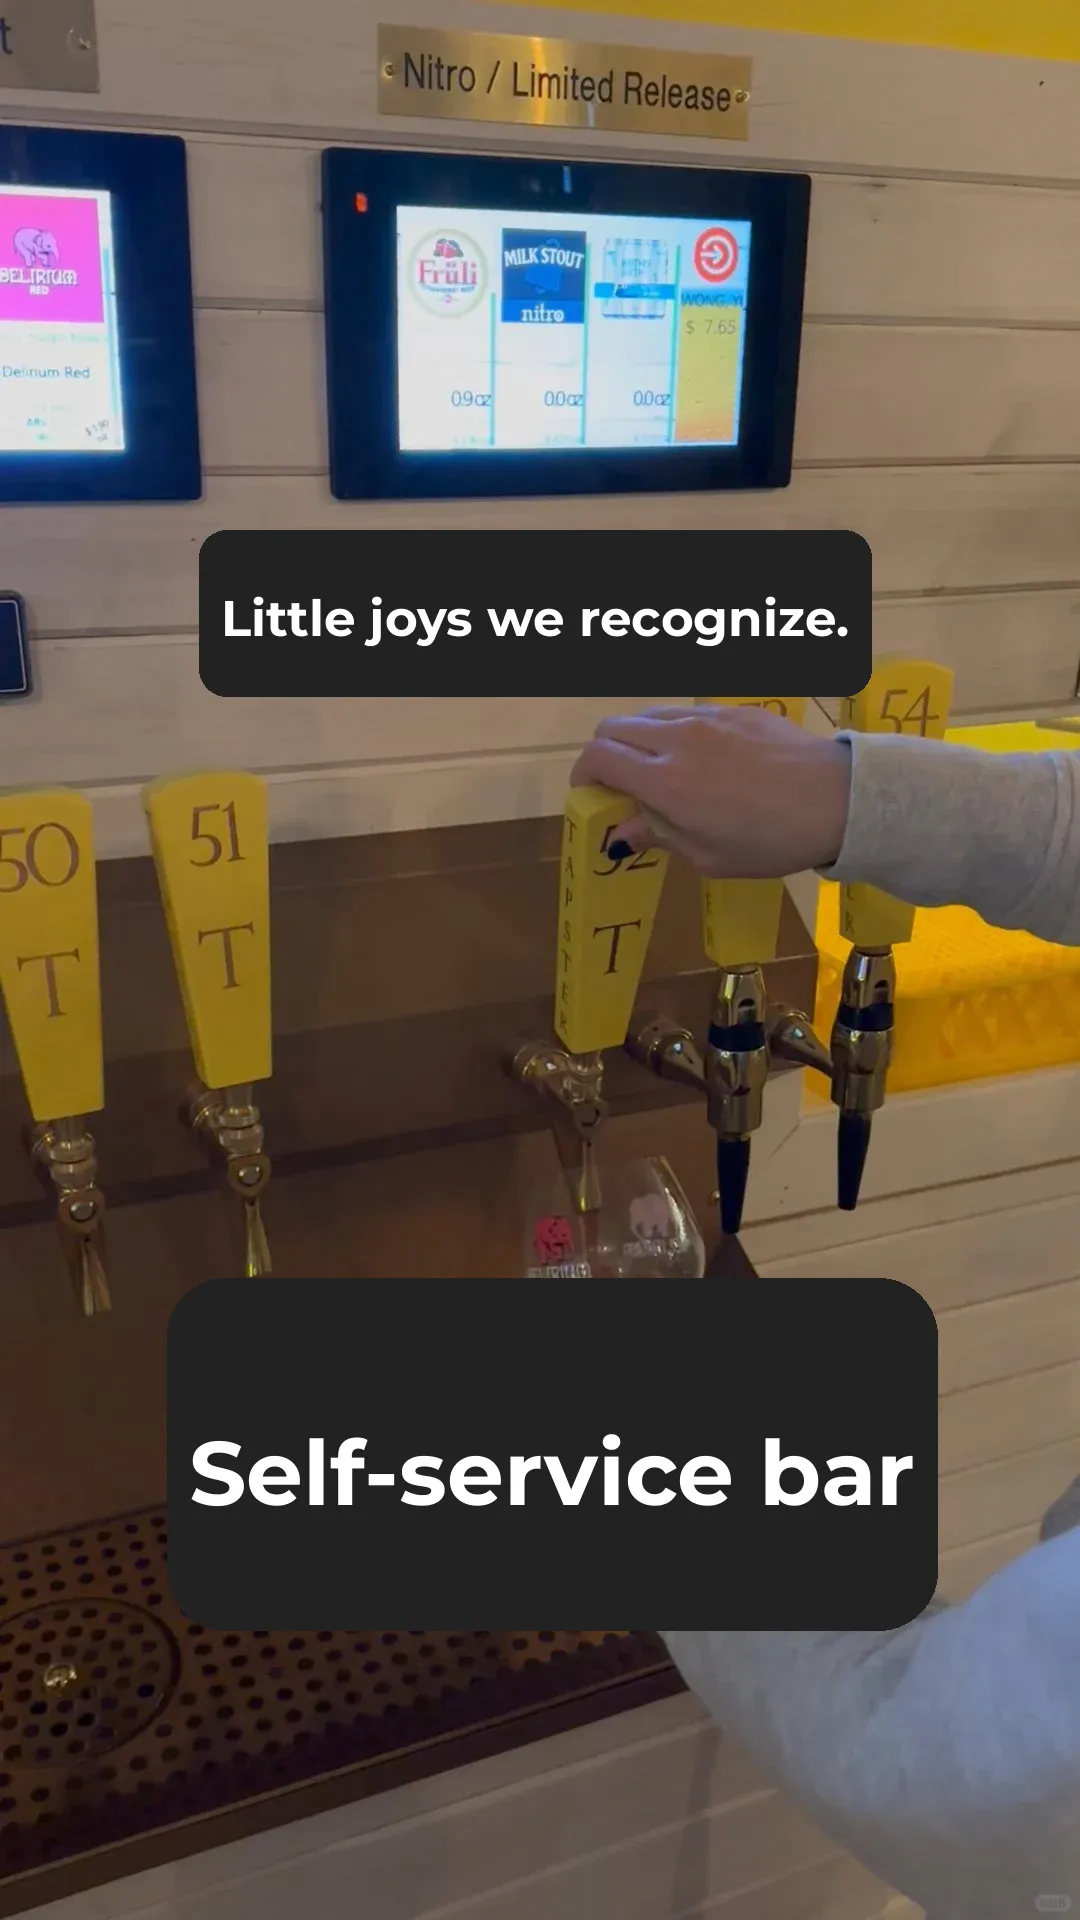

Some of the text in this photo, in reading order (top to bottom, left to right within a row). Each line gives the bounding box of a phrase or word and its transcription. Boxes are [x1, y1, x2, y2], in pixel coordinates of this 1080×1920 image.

[403, 52, 731, 112] Nitro / Limited Release
[418, 259, 477, 285] Früli
[504, 248, 584, 269] MILK STOUT
[521, 303, 564, 322] nitro
[704, 319, 736, 335] 7.65
[2, 365, 90, 378] Delirium Red
[880, 685, 939, 737] 54
[0, 822, 80, 893] 50
[189, 801, 246, 867] 51
[198, 921, 254, 989] T
[593, 919, 642, 975] T
[16, 948, 81, 1018] T
